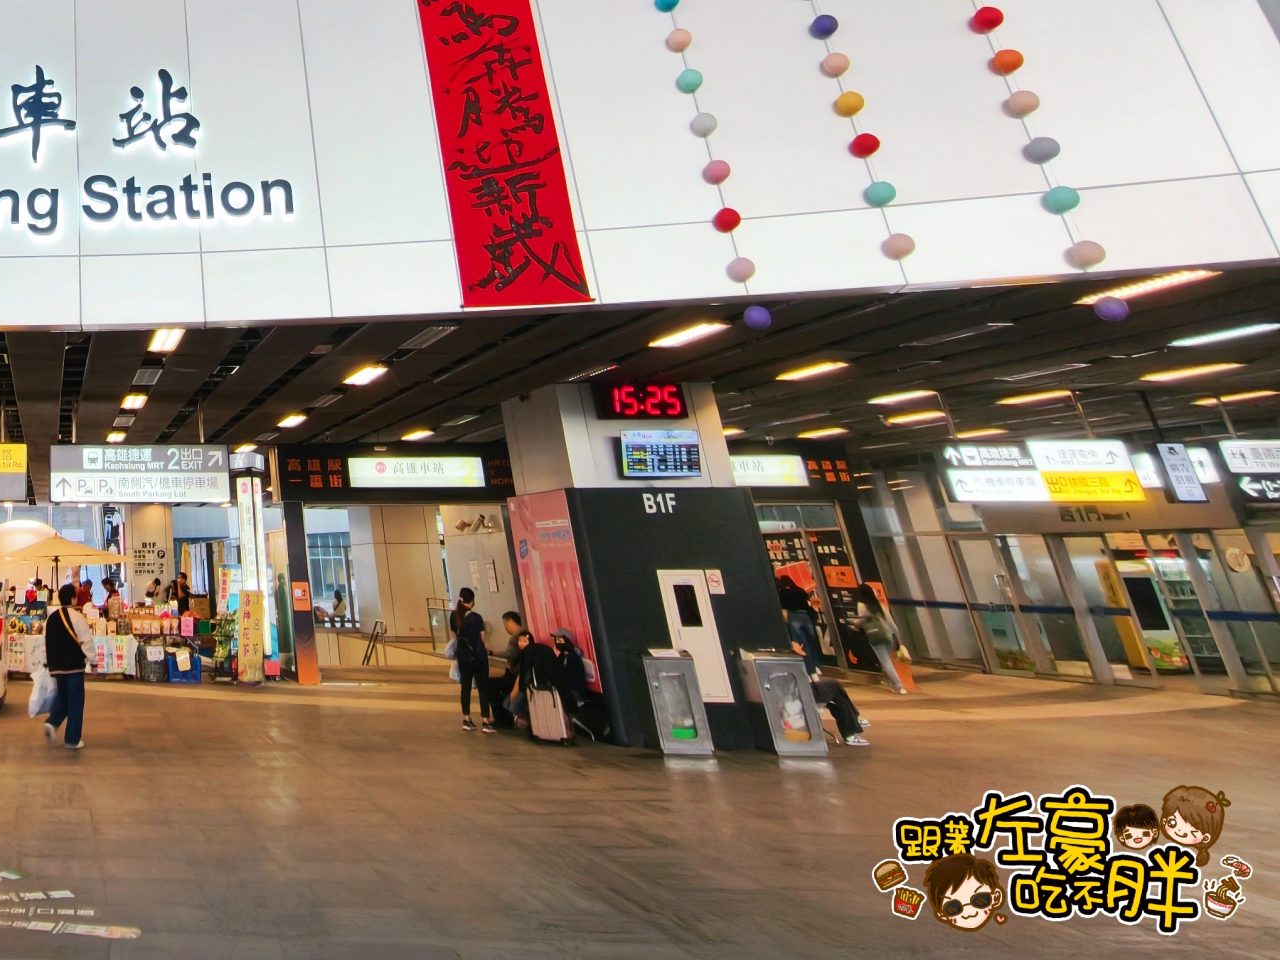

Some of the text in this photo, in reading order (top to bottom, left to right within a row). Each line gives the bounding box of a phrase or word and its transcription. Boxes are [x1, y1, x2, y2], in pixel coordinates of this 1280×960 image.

[81, 171, 296, 222] Station
[611, 385, 681, 416] 15:25
[104, 448, 152, 462] 高雄捷運
[167, 450, 180, 470] 2
[181, 448, 203, 460] 出口
[147, 461, 165, 470] MRT
[181, 461, 203, 470] EXIT
[393, 460, 445, 475] 高雄車站
[118, 489, 186, 499] South Parking Lot
[642, 493, 677, 514] B1F
